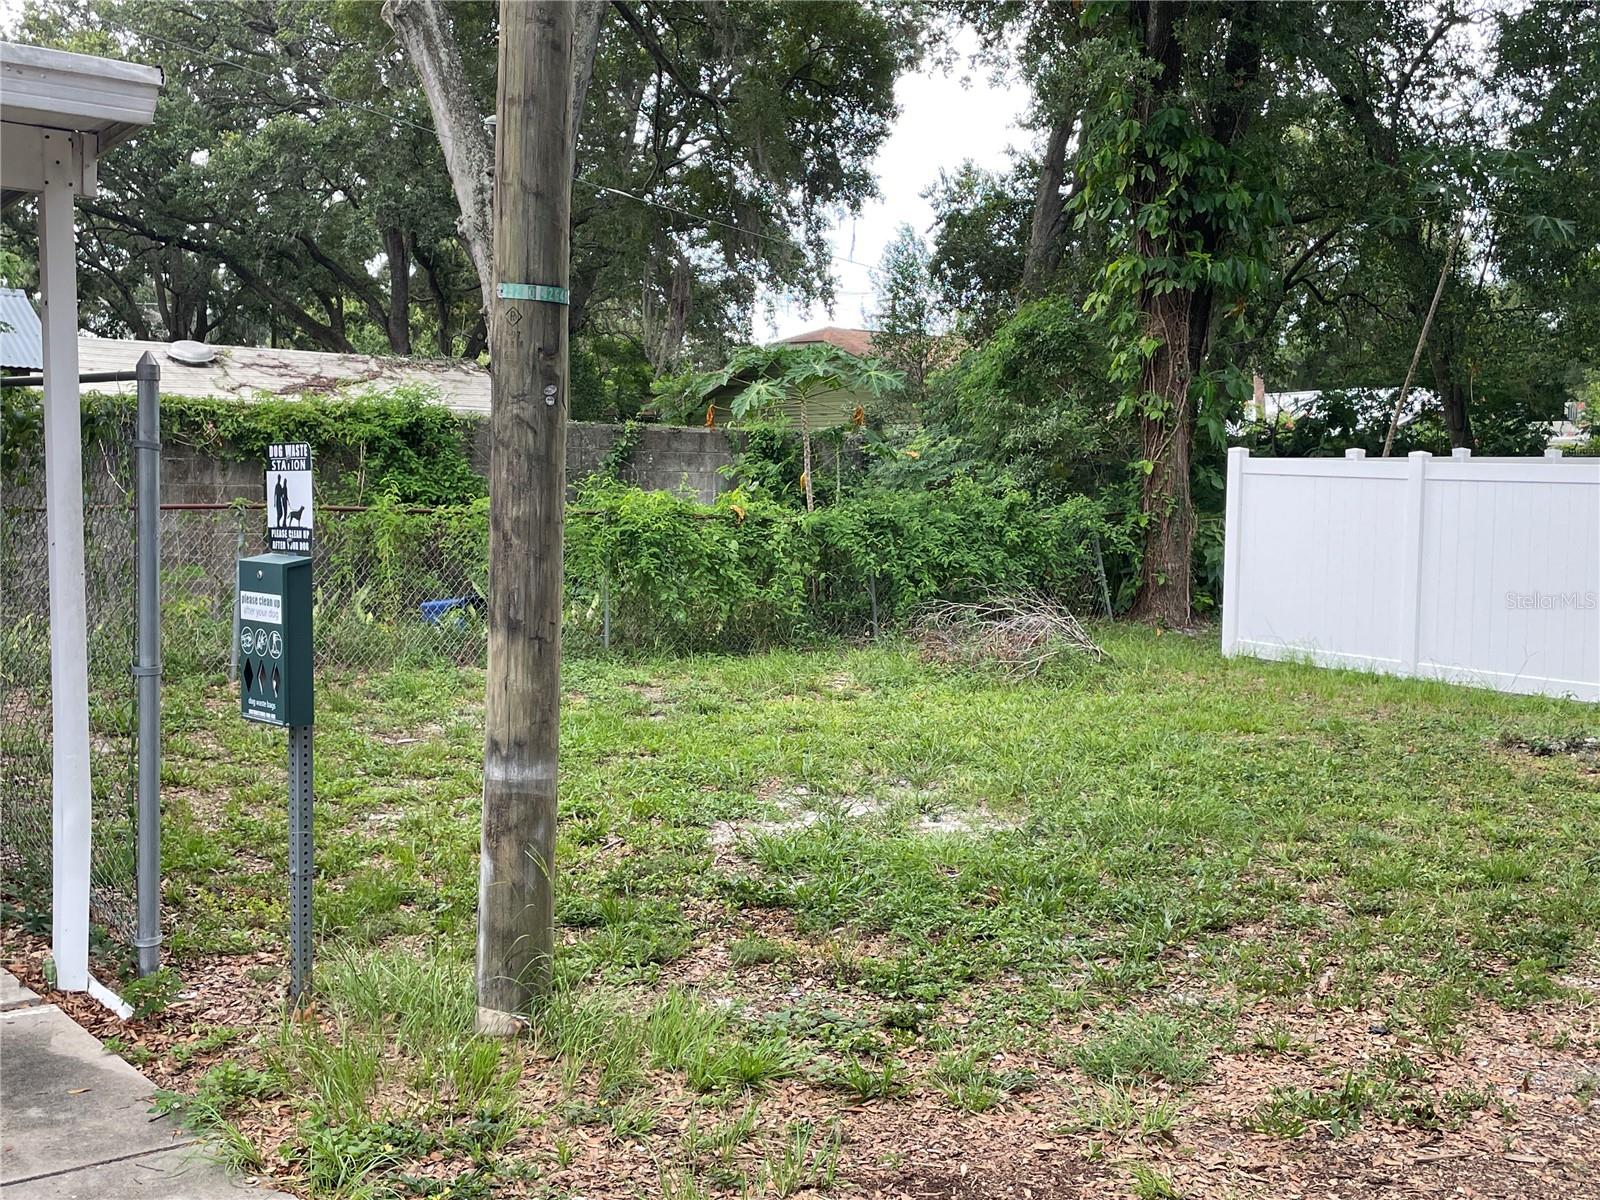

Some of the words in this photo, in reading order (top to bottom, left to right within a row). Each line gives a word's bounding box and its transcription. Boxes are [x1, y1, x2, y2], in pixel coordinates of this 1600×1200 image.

[269, 445, 283, 457] DOG
[285, 444, 307, 457] WASTE
[271, 529, 288, 538] PLEASE
[288, 529, 302, 538] CLEAN
[303, 530, 310, 539] UP
[272, 541, 286, 549] AFTER
[299, 541, 309, 551] DOG
[242, 593, 258, 605] please
[259, 596, 272, 607] clean
[274, 599, 280, 608] up
[255, 610, 267, 618] your
[268, 609, 279, 620] dog
[247, 697, 256, 707] dog
